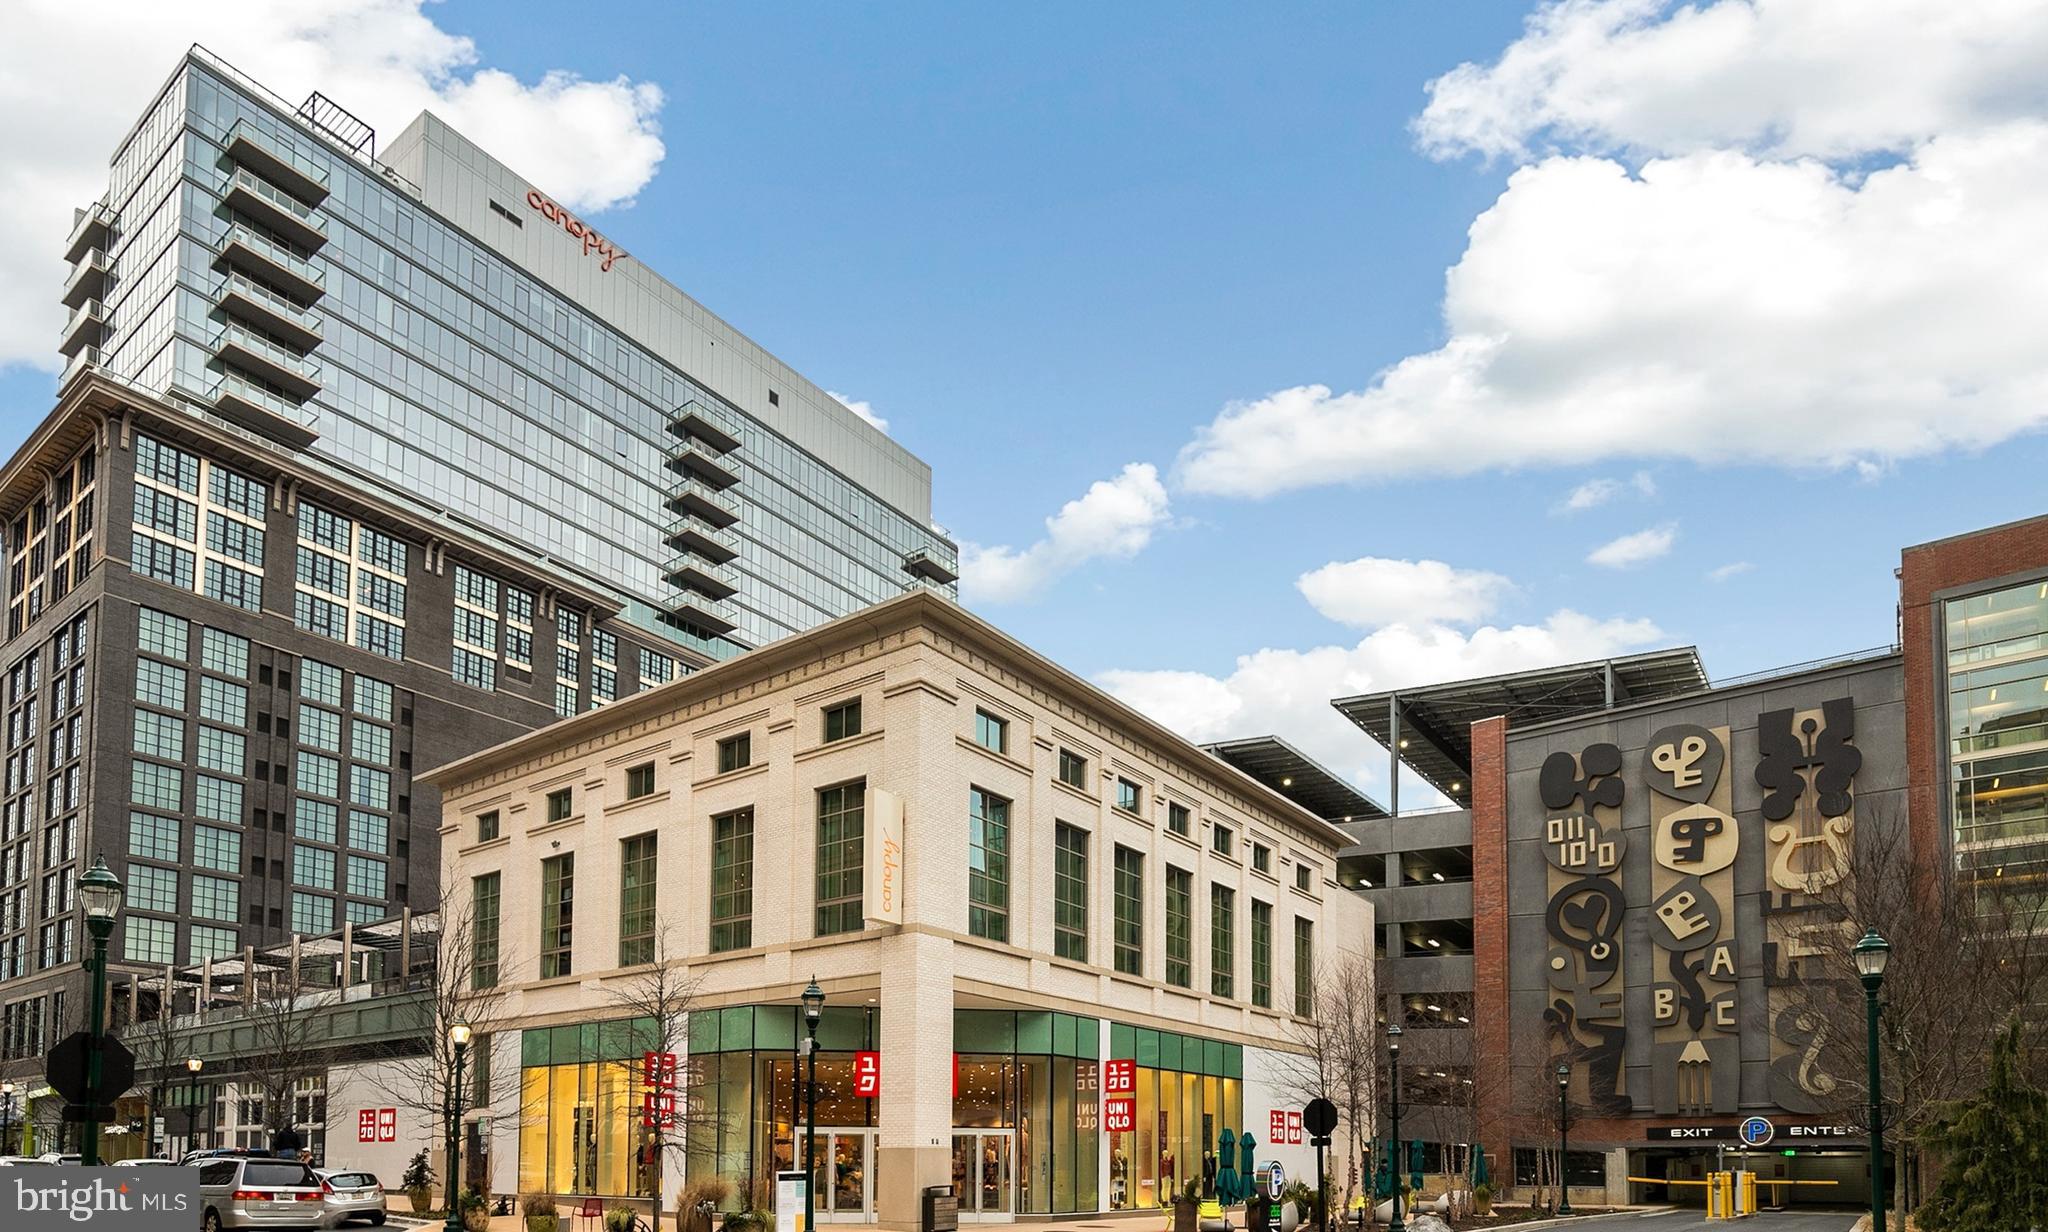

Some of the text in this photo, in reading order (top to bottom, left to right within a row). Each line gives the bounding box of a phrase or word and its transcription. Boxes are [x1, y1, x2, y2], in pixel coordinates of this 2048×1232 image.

[527, 191, 628, 272] canopy
[883, 826, 900, 913] canopy
[1709, 946, 1735, 975] A
[1654, 989, 1674, 1019] B
[380, 1112, 394, 1124] UNI
[1108, 1103, 1128, 1114] UNI
[380, 1126, 394, 1140] QLO
[1108, 1116, 1129, 1129] QLO
[1670, 1128, 1713, 1138] EXIT
[1748, 1121, 1767, 1142] P
[1272, 1169, 1283, 1196] P
